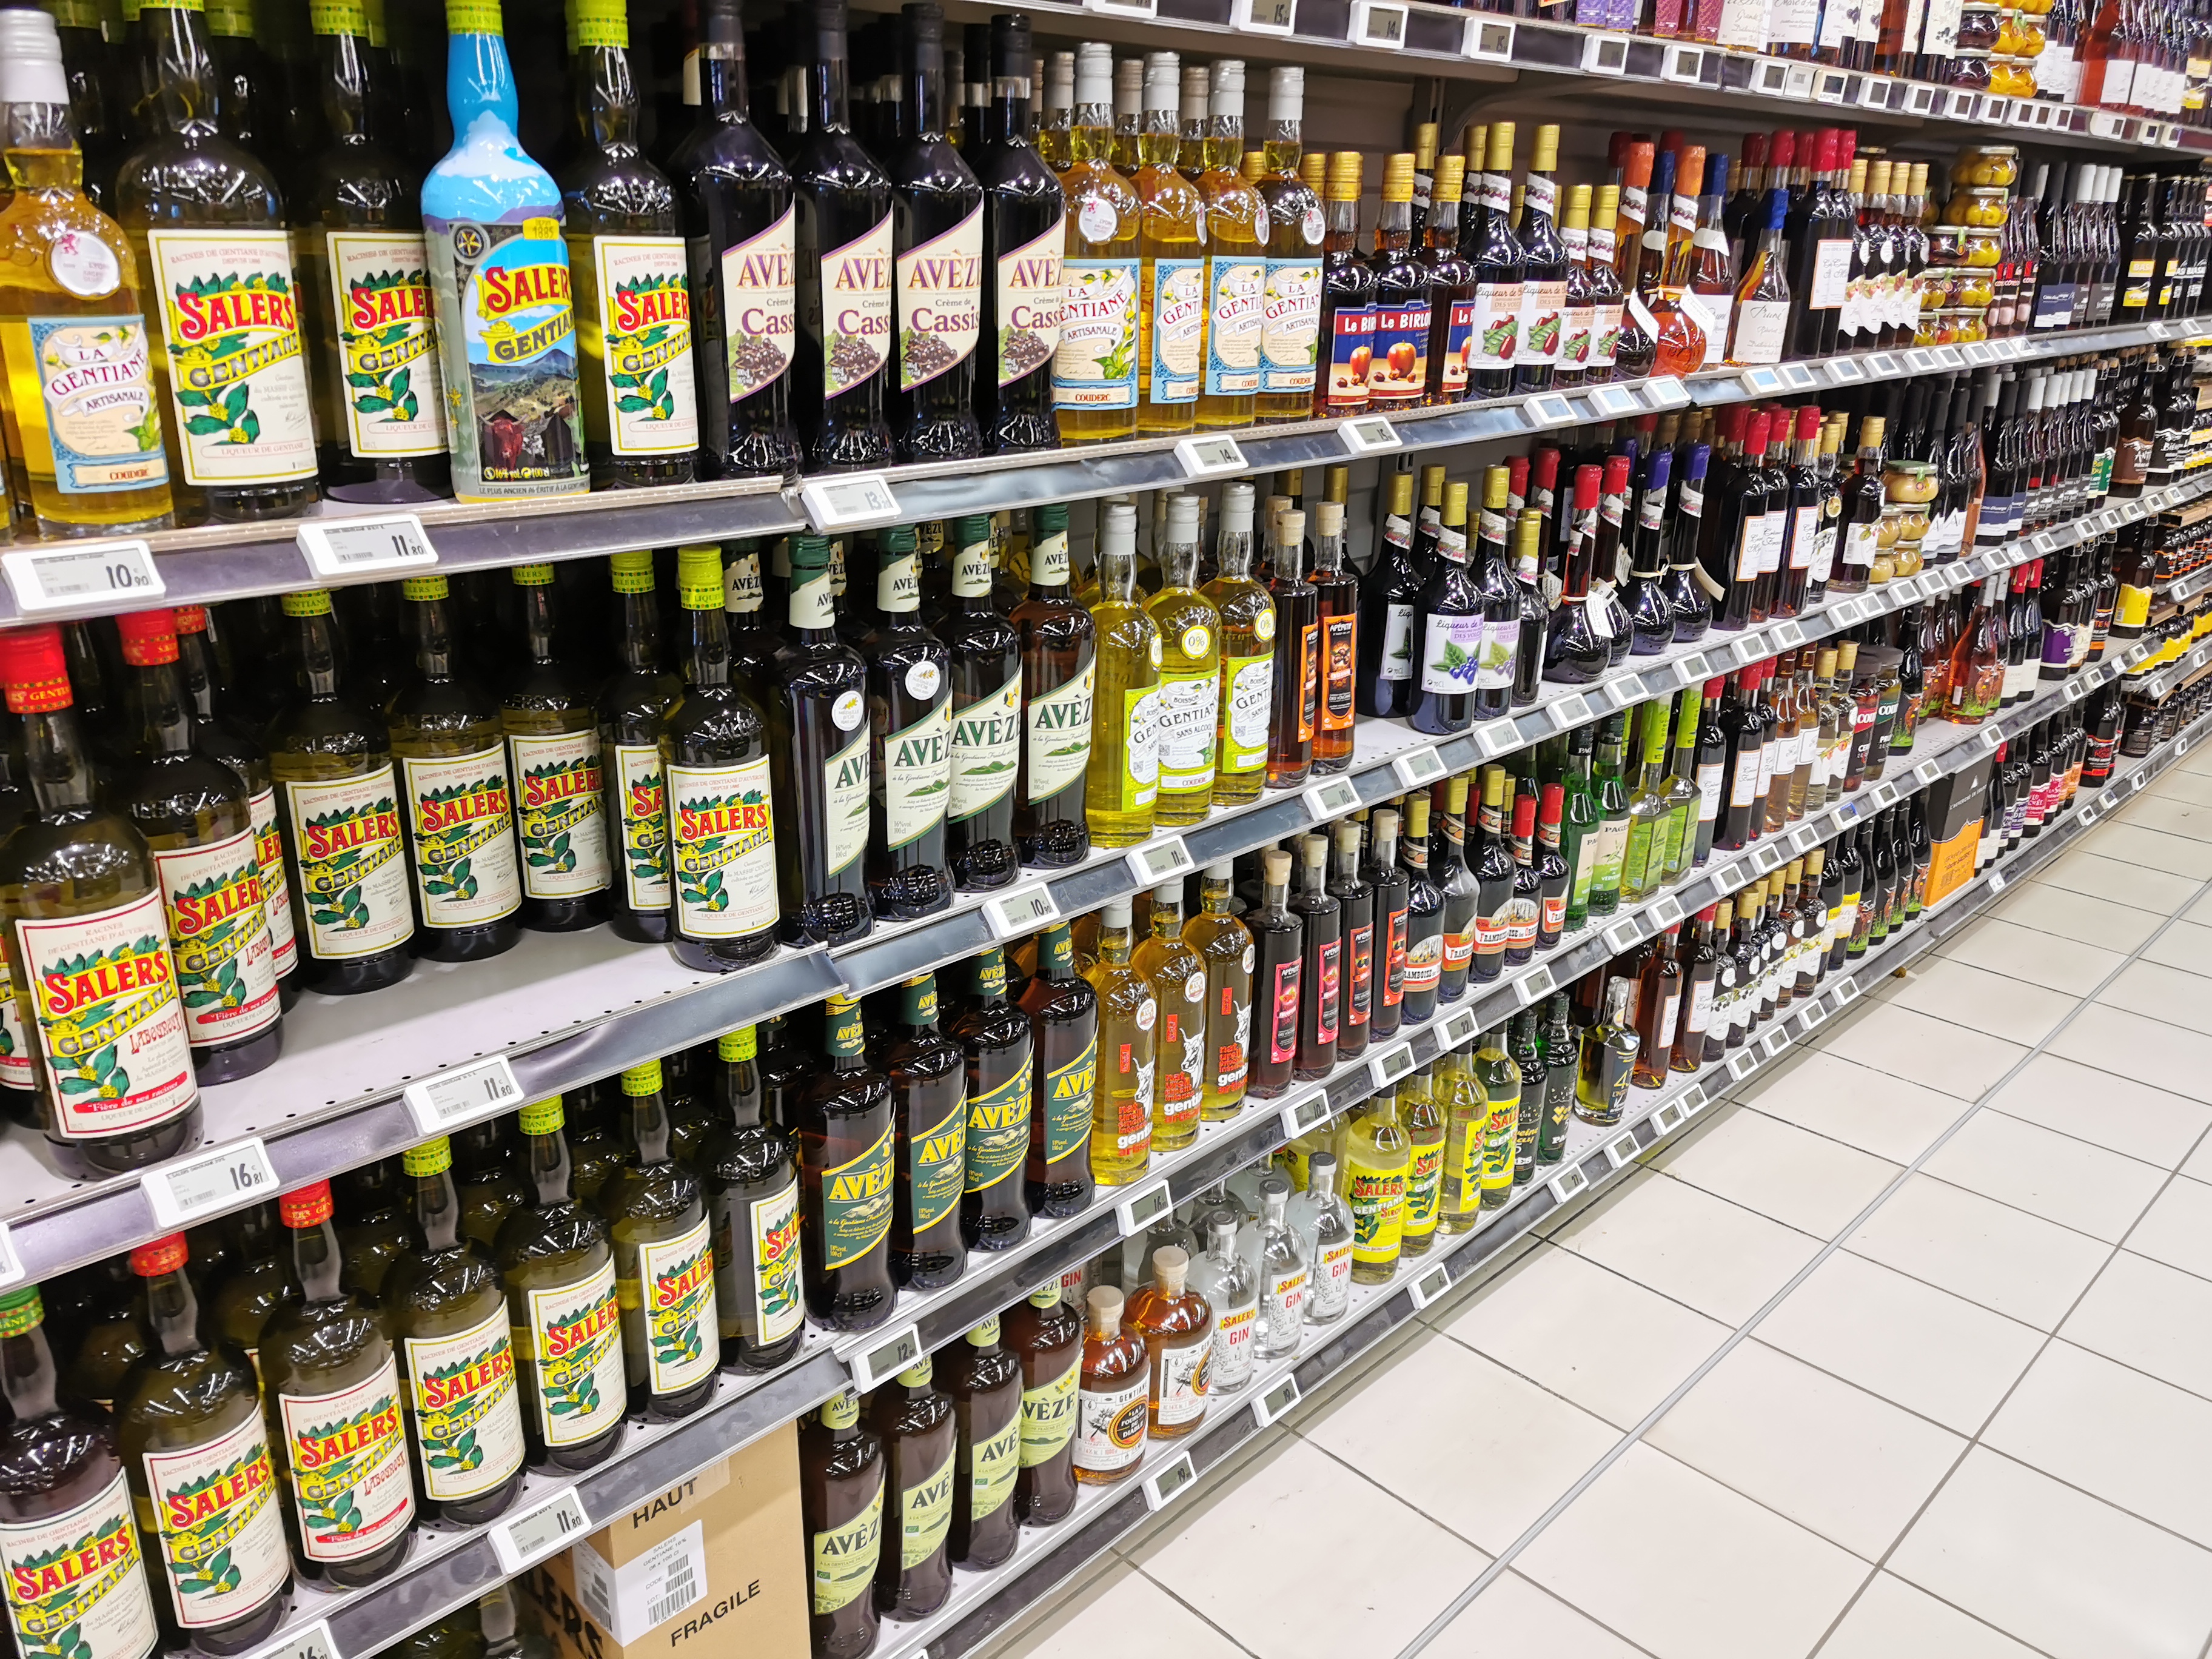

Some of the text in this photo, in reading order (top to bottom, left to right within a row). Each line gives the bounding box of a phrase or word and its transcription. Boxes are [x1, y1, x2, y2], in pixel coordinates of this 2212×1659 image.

[532, 227, 554, 239] 1885
[486, 267, 569, 313] SALER
[1068, 288, 1087, 297] LA
[1185, 287, 1198, 296] LA
[1242, 284, 1255, 292] LA
[1289, 284, 1304, 293] LA
[352, 287, 434, 329] SALER
[617, 289, 690, 331] SALER
[936, 298, 962, 307] Crème
[1060, 289, 1127, 321] ENTIANE
[177, 291, 294, 340] SALERS
[742, 308, 793, 337] Cass
[838, 309, 888, 337] Cass
[1011, 306, 1059, 329] Cass
[1345, 317, 1357, 332] Le
[1381, 313, 1395, 329] Le
[1458, 310, 1468, 323] Le
[495, 315, 575, 361] GENTIA
[1067, 326, 1117, 341] ARTISANALE
[79, 349, 106, 361] LA
[189, 333, 298, 387] GENTIANE
[360, 329, 437, 370] GENTIA
[51, 347, 147, 396] GENTIANE
[85, 391, 144, 411] ARTISANALE
[221, 447, 258, 455] LIQUEUR
[273, 443, 304, 452] GENTIANE
[391, 534, 424, 557] 11 80
[106, 563, 149, 589] 10 90
[1259, 618, 1272, 631] 0%
[1436, 620, 1469, 631] Liqueur
[1188, 635, 1205, 647] 0%
[1173, 694, 1199, 703] BOISSON
[1176, 729, 1193, 738] SANS
[422, 789, 508, 833] SALERS
[681, 803, 768, 841] SALERS
[306, 812, 397, 859] SALERS
[428, 812, 511, 864] GENTIANE
[684, 825, 770, 874] GENTIANE
[315, 836, 403, 891] GENTIANE
[702, 911, 726, 919] LIQUEUR
[737, 905, 764, 916] GENTIANE
[85, 922, 123, 937] RACINES
[45, 950, 169, 1015] SALERS
[58, 980, 173, 1056] GENTIANE
[484, 1078, 512, 1101] 11 80
[1416, 1152, 1444, 1176] SALE
[230, 1163, 263, 1190] 16 81
[1355, 1179, 1404, 1197] SALERS
[1353, 1195, 1404, 1213] GENTIANE
[657, 1250, 713, 1307] SALER
[1061, 1270, 1082, 1288] GIN
[1332, 1261, 1349, 1278] GIN
[1285, 1292, 1303, 1309] GIN
[1222, 1311, 1256, 1330] SALERS
[1230, 1328, 1250, 1345] GIN
[425, 1347, 511, 1409] SALERS
[1119, 1381, 1147, 1403] GENTIANE
[431, 1370, 515, 1439] GENTIANE
[300, 1407, 397, 1468] SALERS
[1122, 1421, 1144, 1438] DIABLE
[307, 1430, 402, 1499] GENTIANE
[169, 1453, 269, 1529] SALERS
[632, 1477, 699, 1529] HAUT
[179, 1475, 275, 1561] GENTIANE
[557, 1510, 581, 1533] 11 80
[643, 1546, 673, 1566] GENTIANE
[653, 1537, 676, 1553] SALERS
[14, 1526, 130, 1600] SALERS
[663, 1554, 672, 1563] 100
[26, 1550, 136, 1634] GENTIANE
[671, 1579, 760, 1647] FRAGILE
